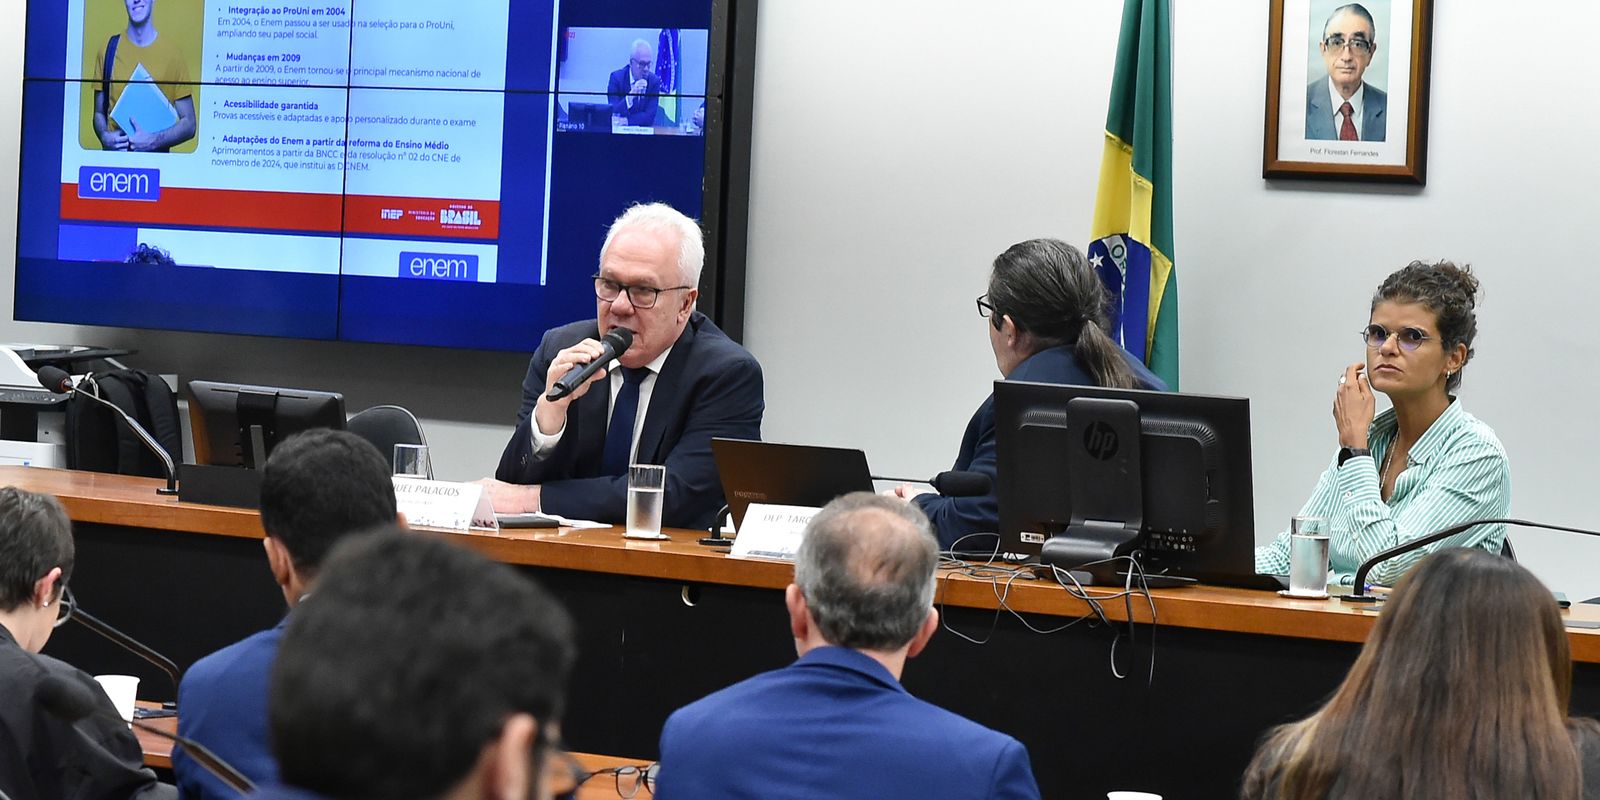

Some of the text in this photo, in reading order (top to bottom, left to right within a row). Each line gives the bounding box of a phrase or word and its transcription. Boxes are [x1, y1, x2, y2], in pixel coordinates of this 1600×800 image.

[228, 6, 270, 16] Integração
[283, 7, 310, 16] ProUni
[326, 8, 345, 16] 2004
[218, 18, 232, 26] Em
[232, 18, 252, 26] 2004,
[261, 18, 282, 26] Enem
[284, 20, 310, 28] passou
[369, 20, 398, 30] seleção
[400, 22, 417, 30] para
[426, 20, 454, 30] ProUni,
[217, 30, 256, 38] ampliando
[274, 30, 294, 39] papel
[226, 53, 266, 62] Mudanças
[282, 54, 300, 62] 2009
[222, 64, 242, 73] partir
[244, 64, 254, 72] de
[256, 65, 276, 74] 2009,
[308, 67, 344, 75] tornou-se
[354, 68, 386, 76] principal
[388, 69, 434, 77] mecanismo
[436, 70, 469, 78] nacional
[470, 70, 481, 78] de
[224, 100, 318, 110] Acessibilidade garantida
[214, 111, 238, 120] Provas
[240, 112, 275, 120] acessíveis
[284, 113, 322, 123] adaptadas
[331, 116, 353, 124] apoo
[355, 113, 408, 124] personalizado
[410, 116, 440, 125] durante
[222, 135, 268, 145] Adaptações
[270, 136, 280, 144] do
[282, 136, 304, 145] Enem
[312, 138, 334, 146] partir
[336, 138, 346, 146] da
[349, 138, 380, 148] reforma
[383, 140, 393, 148] do
[396, 140, 422, 148] Ensino
[424, 140, 449, 150] Médio
[212, 146, 274, 156] Aprimoramentos
[282, 148, 302, 158] partir
[304, 150, 314, 158] da
[316, 150, 338, 158] BNCC
[360, 152, 396, 161] resolução
[432, 154, 448, 162] CNE
[450, 154, 460, 162] de
[212, 159, 249, 167] novembro
[251, 159, 260, 167] de
[262, 160, 282, 169] 2024,
[284, 162, 298, 170] que
[90, 172, 148, 193] enem
[440, 209, 482, 226] BRASIL
[410, 257, 468, 278] enem
[1089, 421, 1115, 460] hp
[414, 484, 460, 497] PALACIOS
[788, 514, 810, 524] TARC
